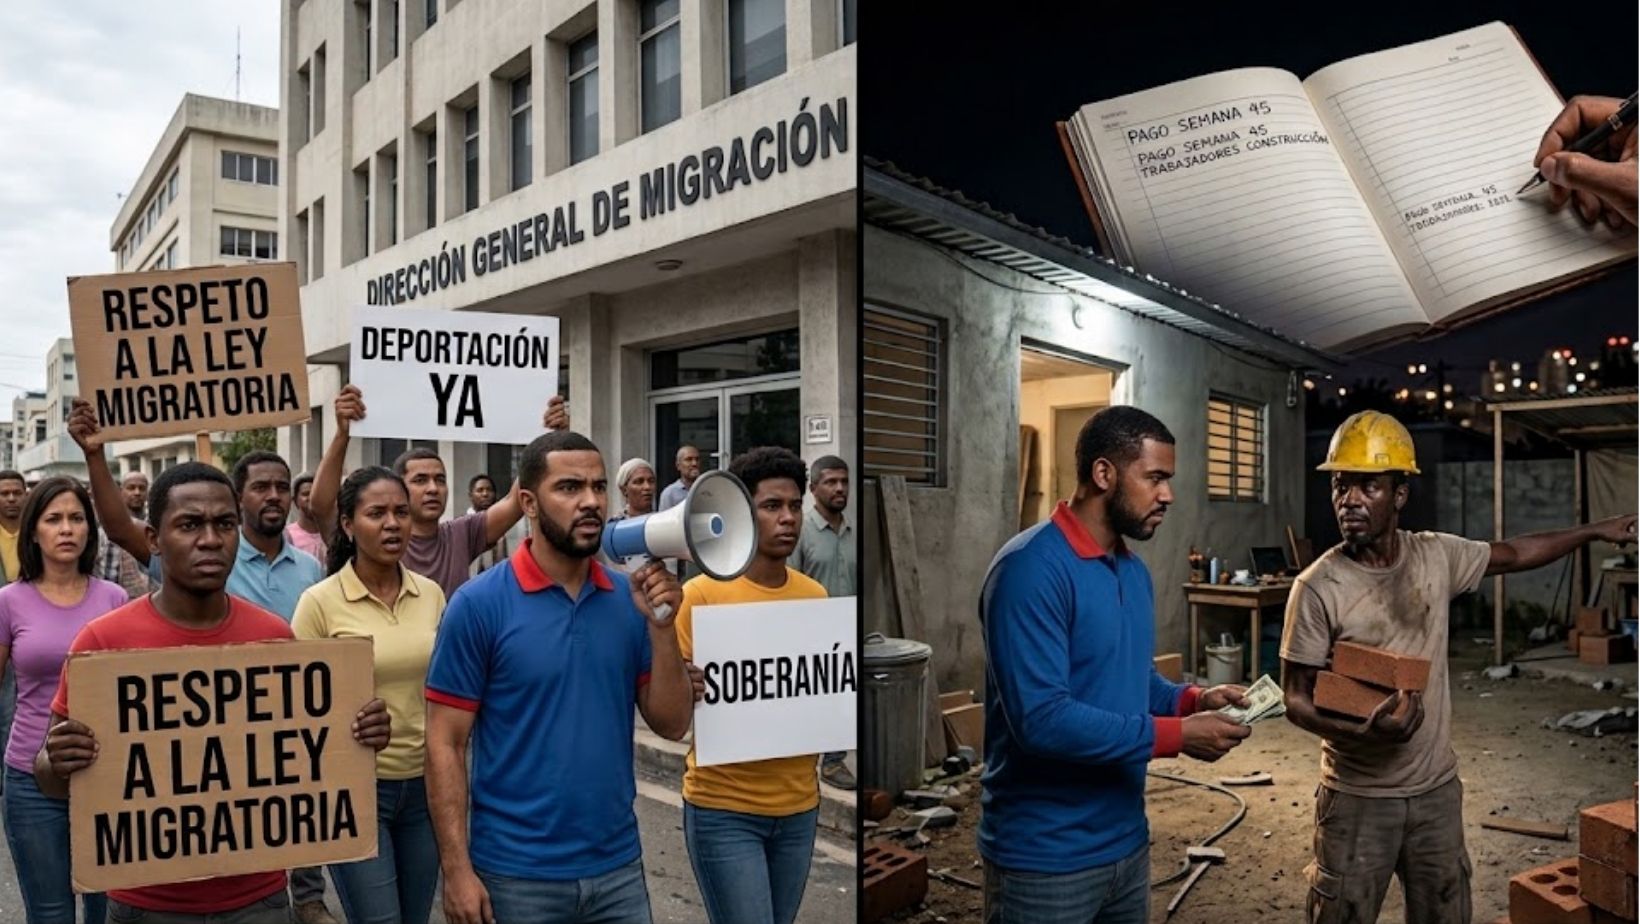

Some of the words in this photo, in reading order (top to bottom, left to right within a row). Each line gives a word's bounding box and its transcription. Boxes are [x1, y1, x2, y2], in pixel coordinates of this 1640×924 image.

[1127, 124, 1169, 144] PAGO
[1178, 107, 1242, 132] SEMANA
[1249, 101, 1271, 115] 45
[1138, 146, 1175, 165] PAGO
[1183, 131, 1240, 153] SEMANA
[1249, 124, 1268, 137] 45
[1140, 144, 1240, 178] TRABAJADORES
[367, 240, 466, 306] DIRECCIÓN
[471, 206, 584, 277] GENERAL
[592, 181, 631, 237] DE
[639, 96, 849, 221] MIGRACIÓN
[102, 276, 269, 333] RESPETO
[115, 338, 139, 380] A
[148, 334, 194, 377] LA
[204, 327, 267, 372] LEY
[361, 326, 549, 369] DEPORTACIÓN
[96, 373, 299, 427] MIGRATORIA
[429, 372, 484, 428] YA
[117, 661, 332, 733] RESPETO
[704, 642, 857, 705] SOBERANÍA
[123, 743, 155, 800] A
[171, 736, 231, 795] LA
[246, 726, 330, 788] LEY
[94, 789, 358, 866] MIGRATORIA
